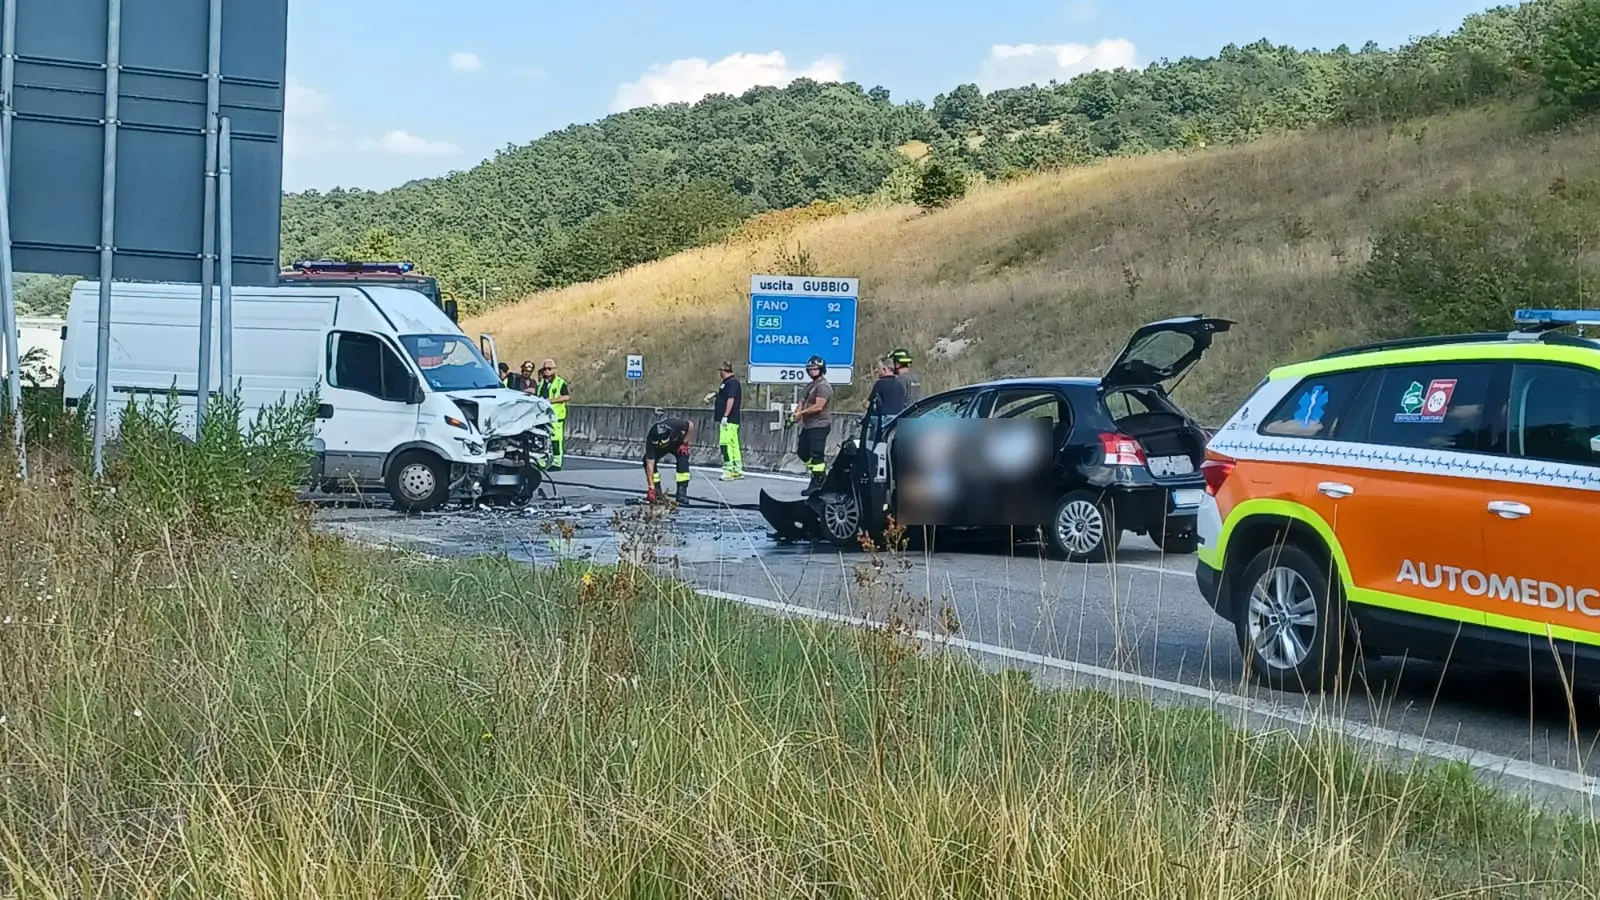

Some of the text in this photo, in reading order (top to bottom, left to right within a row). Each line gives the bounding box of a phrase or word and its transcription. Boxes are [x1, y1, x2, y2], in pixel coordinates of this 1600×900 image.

[760, 280, 849, 292] uscita GUBBIO
[756, 300, 841, 312] FANO 92
[758, 317, 840, 329] E45 34
[755, 334, 839, 346] CAPRARA 2
[780, 370, 804, 380] 250
